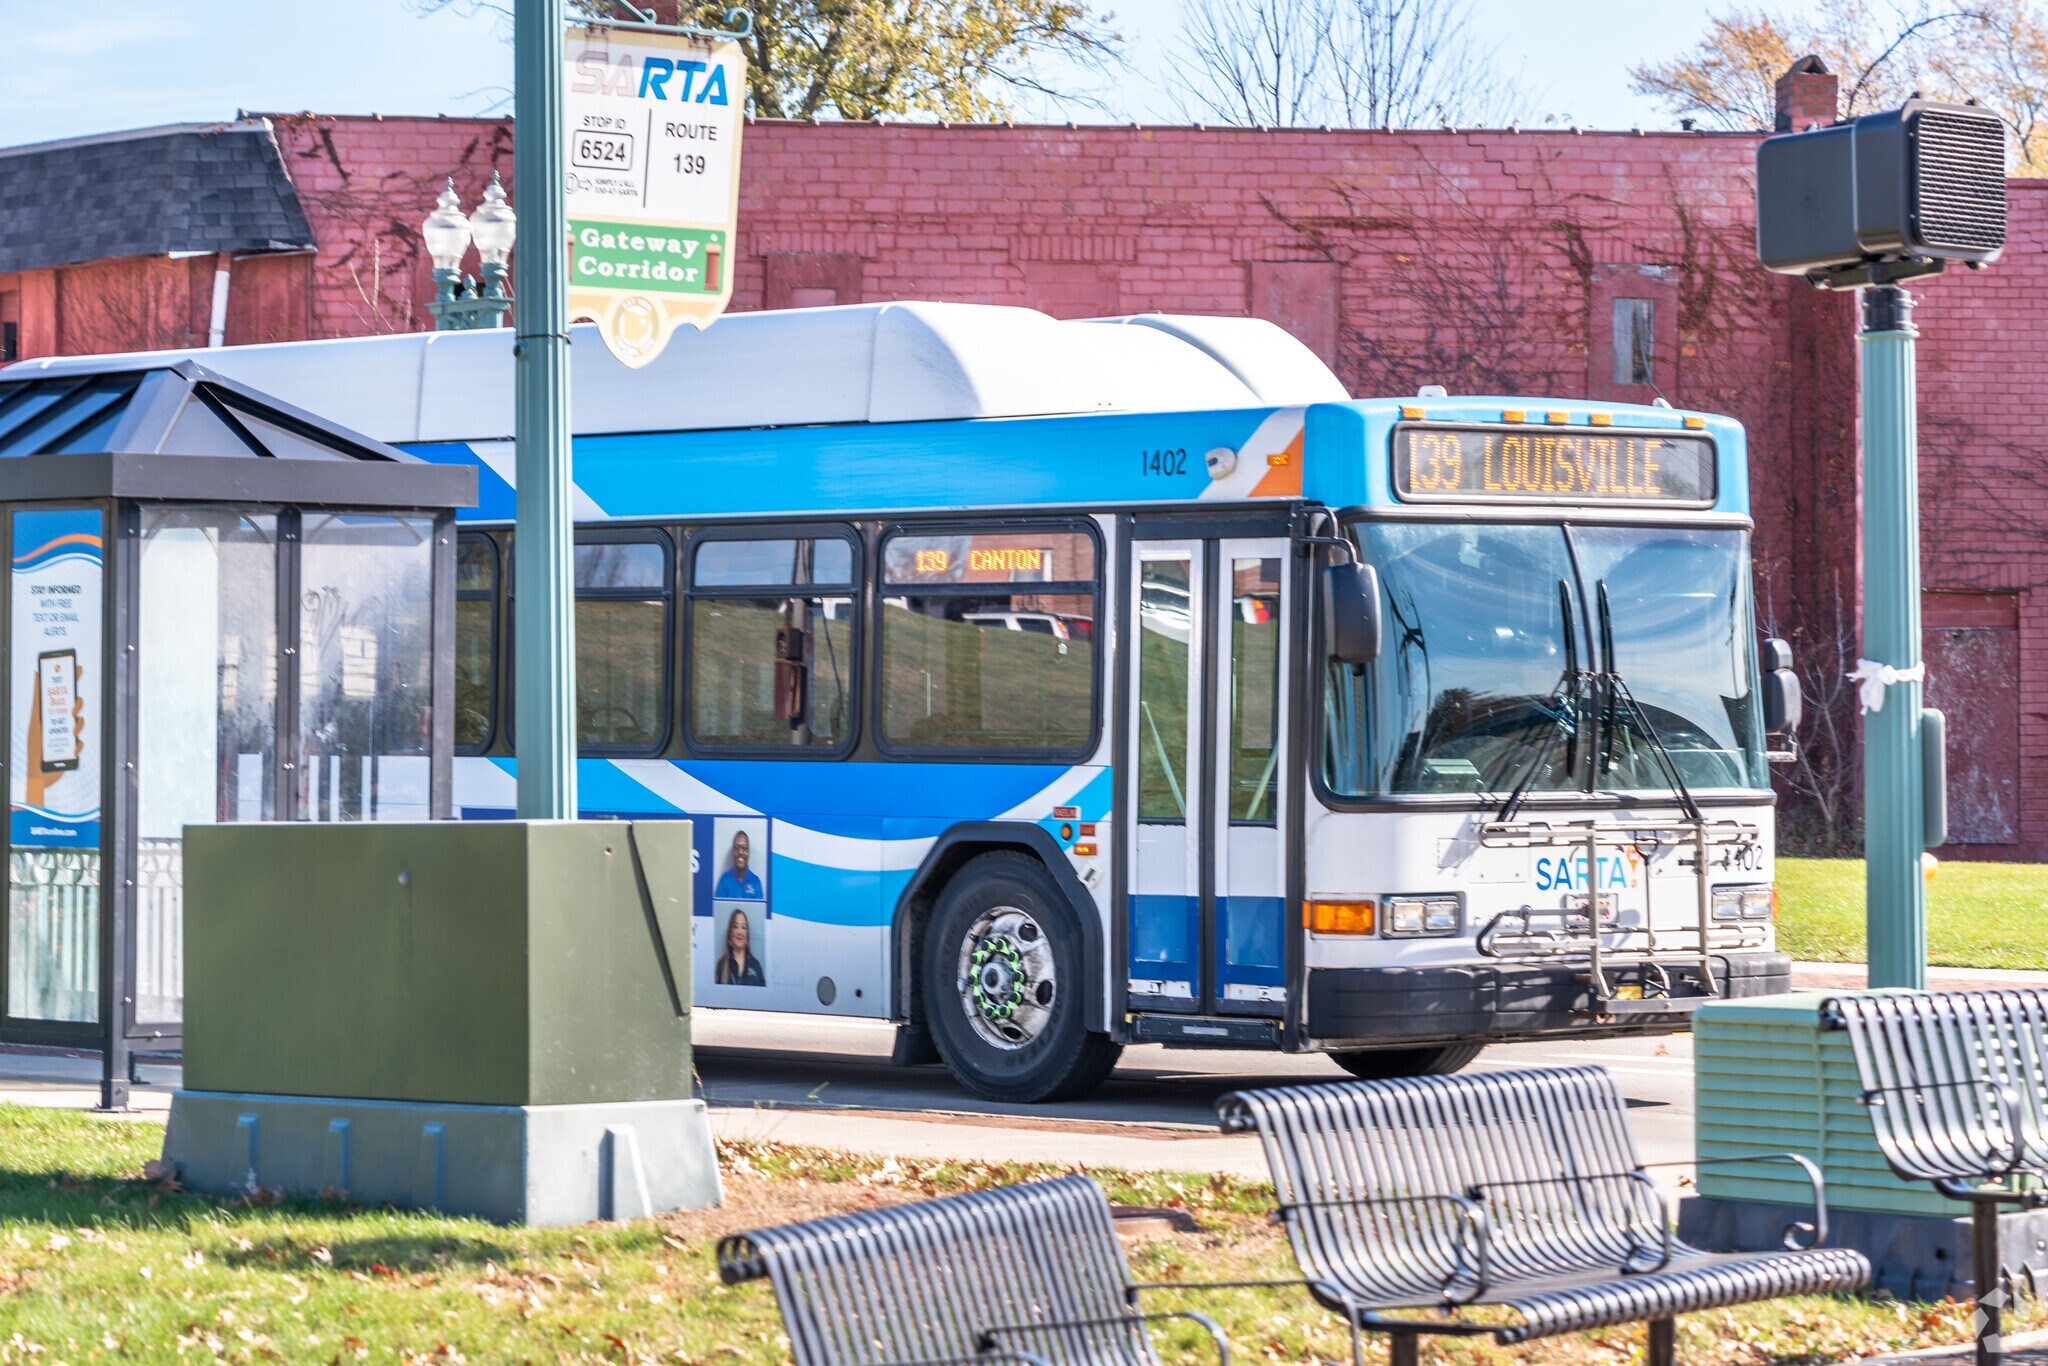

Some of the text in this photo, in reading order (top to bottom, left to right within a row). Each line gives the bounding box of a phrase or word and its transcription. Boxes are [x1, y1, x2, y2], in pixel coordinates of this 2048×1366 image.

[571, 50, 728, 106] SARTA
[583, 115, 627, 130] STOP ID
[665, 122, 718, 142] ROUTE
[580, 139, 626, 162] 6524
[673, 153, 705, 175] 139
[580, 227, 699, 260] Gateway
[578, 255, 699, 283] Corridor
[1142, 448, 1187, 476] 1402
[1409, 433, 1662, 495] 139 LOUISVILLE
[916, 549, 1041, 572] 139 CANTON
[31, 584, 82, 595] STAY INFORMED
